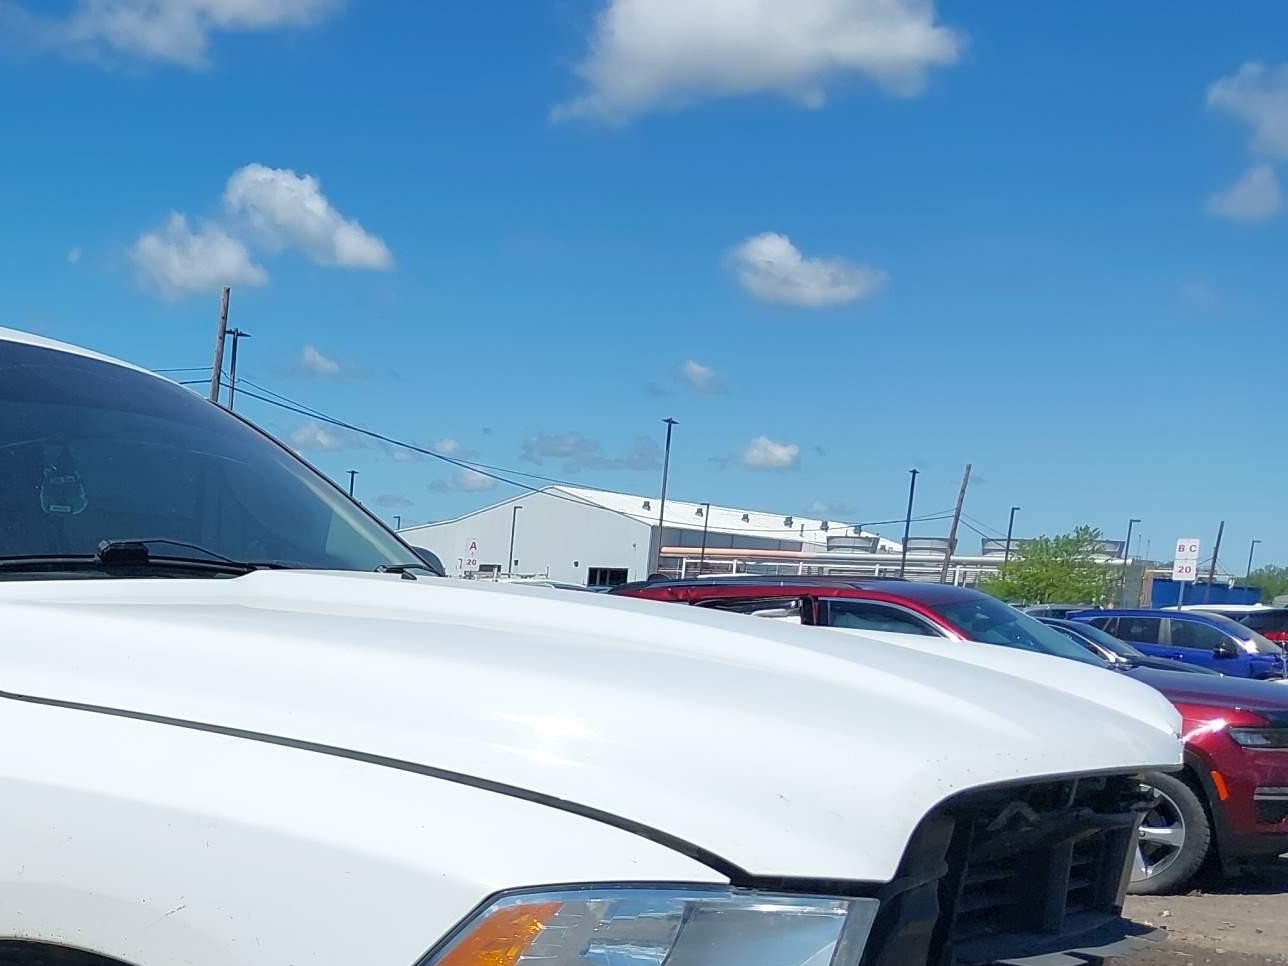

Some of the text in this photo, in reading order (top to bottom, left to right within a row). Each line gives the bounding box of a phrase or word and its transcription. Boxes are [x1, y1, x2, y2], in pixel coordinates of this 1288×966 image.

[469, 541, 477, 551] A
[1189, 544, 1197, 553] C
[1178, 566, 1192, 574] 20
